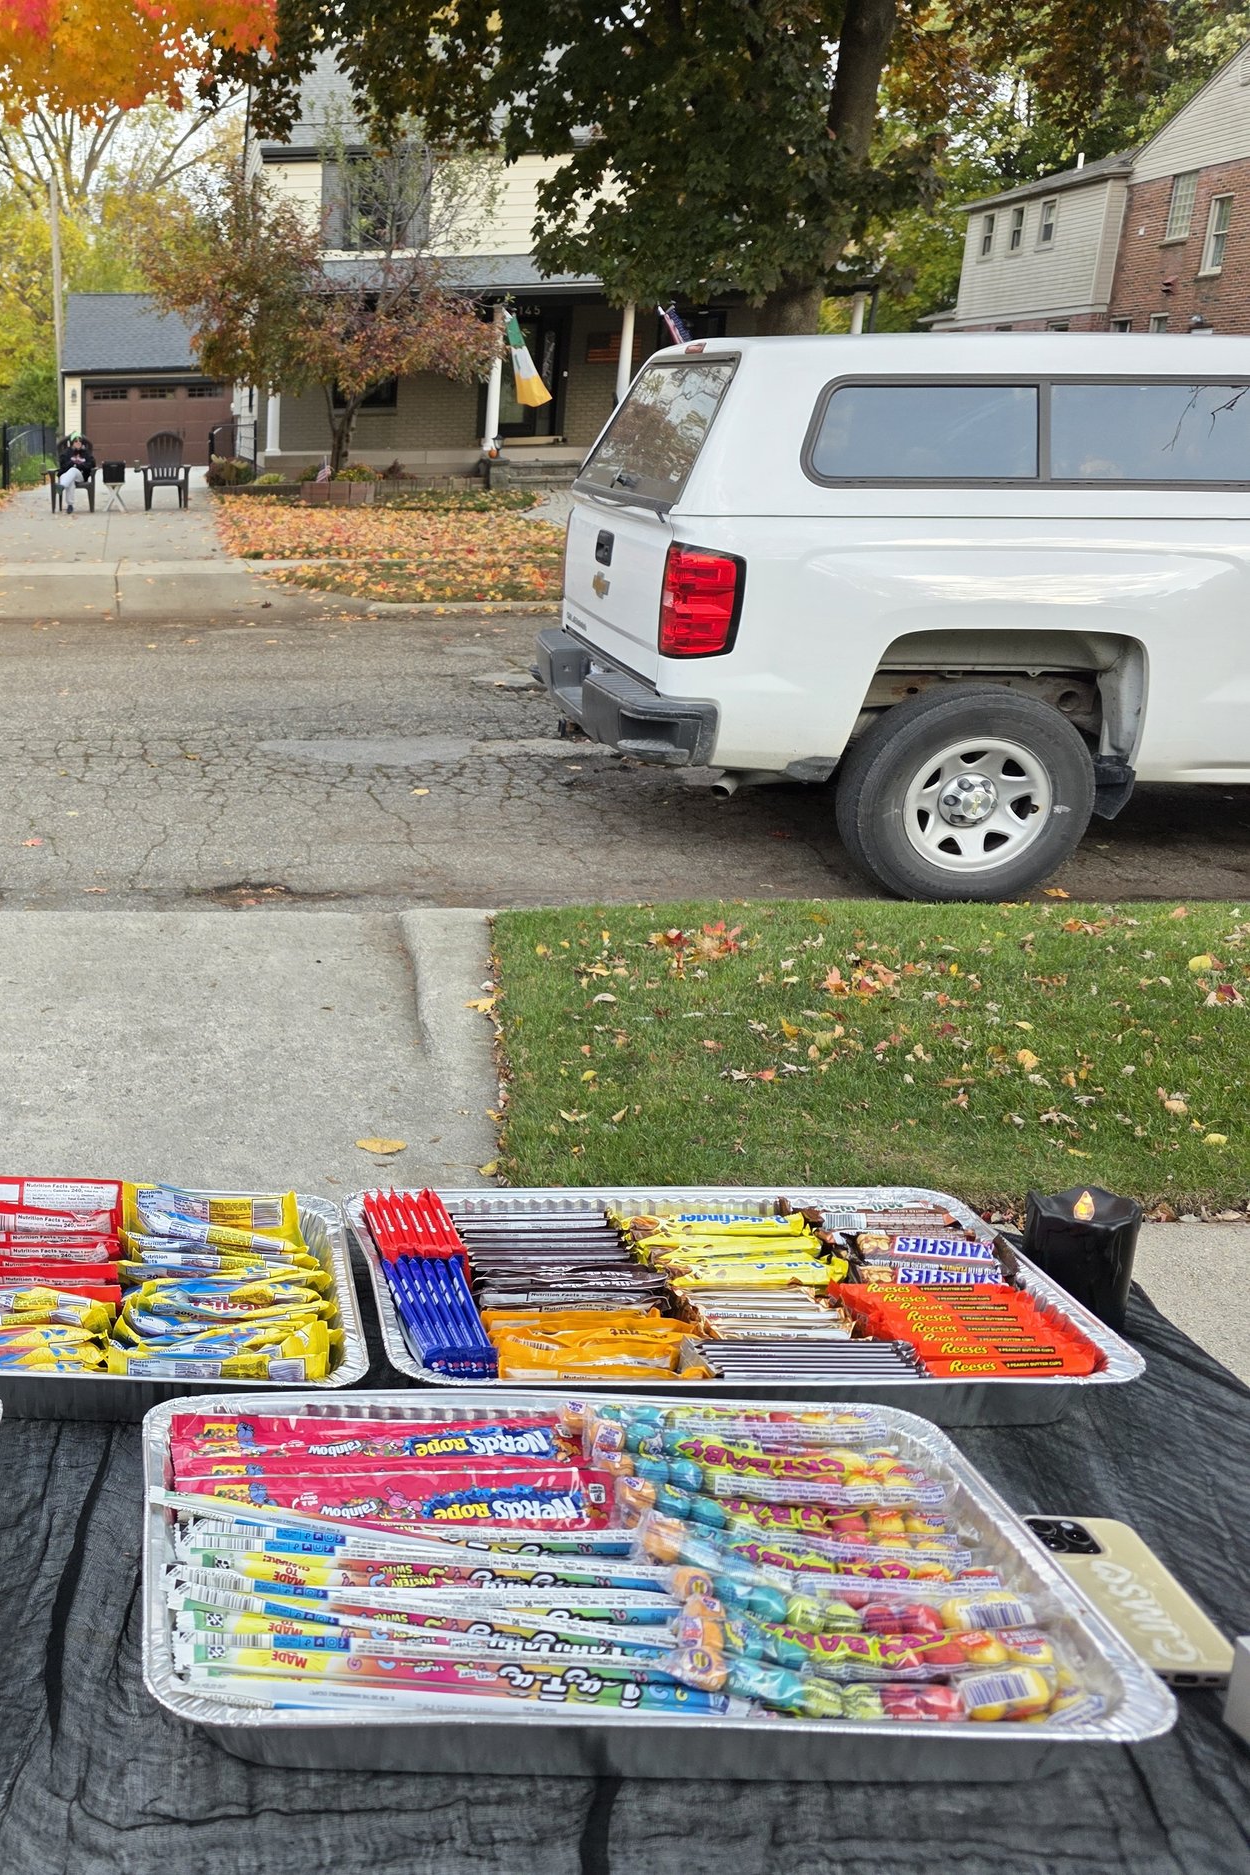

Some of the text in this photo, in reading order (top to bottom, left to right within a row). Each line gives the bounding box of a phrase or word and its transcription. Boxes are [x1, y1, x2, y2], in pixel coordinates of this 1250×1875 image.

[897, 1237, 993, 1260] SATISFIES
[899, 1268, 999, 1284] SATISFIES
[867, 1283, 910, 1293] Reese's
[883, 1294, 927, 1303] Reese's
[906, 1311, 952, 1322] Reese's
[911, 1322, 958, 1333] Reese's
[941, 1343, 988, 1354] Reese's
[949, 1360, 997, 1373] Reese's
[308, 1440, 361, 1456] rainbow
[677, 1438, 845, 1476] CRY BABY
[320, 1500, 377, 1519] rainbow
[272, 1571, 306, 1586] MADE
[285, 1567, 298, 1577] TO
[391, 1577, 436, 1588] MYSTERY
[271, 1650, 308, 1668] MADE
